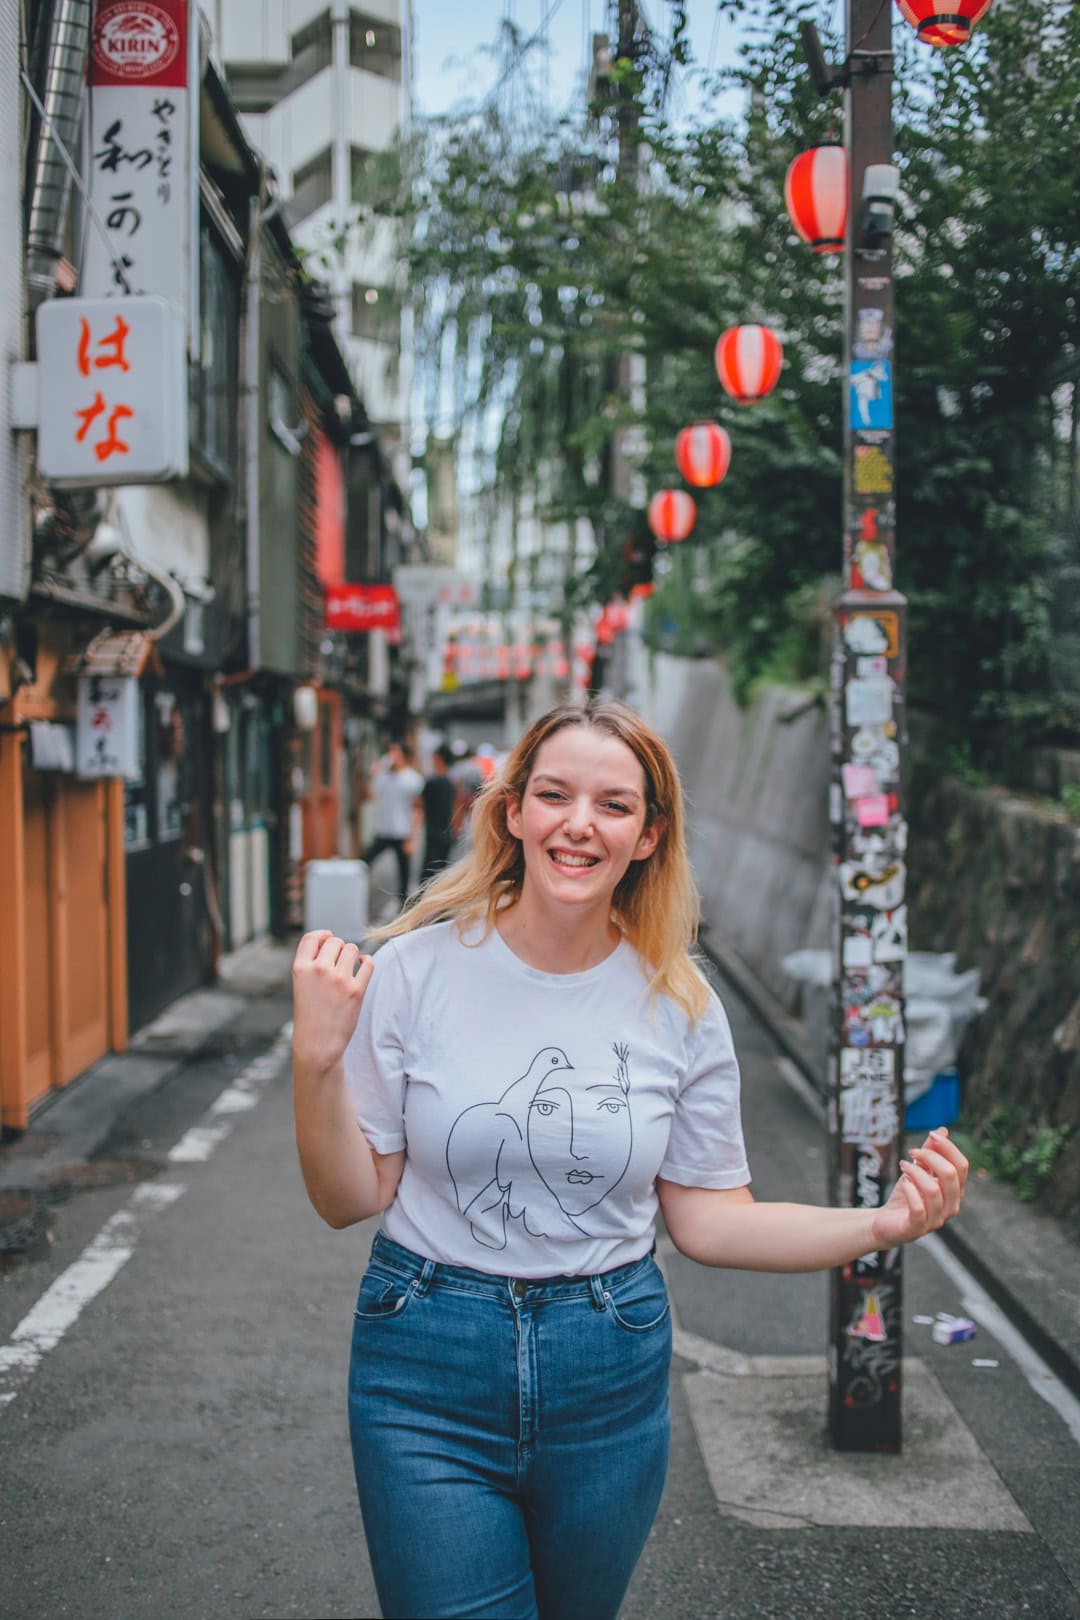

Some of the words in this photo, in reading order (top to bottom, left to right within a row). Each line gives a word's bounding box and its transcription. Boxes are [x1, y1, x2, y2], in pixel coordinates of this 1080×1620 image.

[108, 39, 160, 53] KIRIN
[151, 99, 176, 204] やきとり
[74, 314, 135, 463] はな
